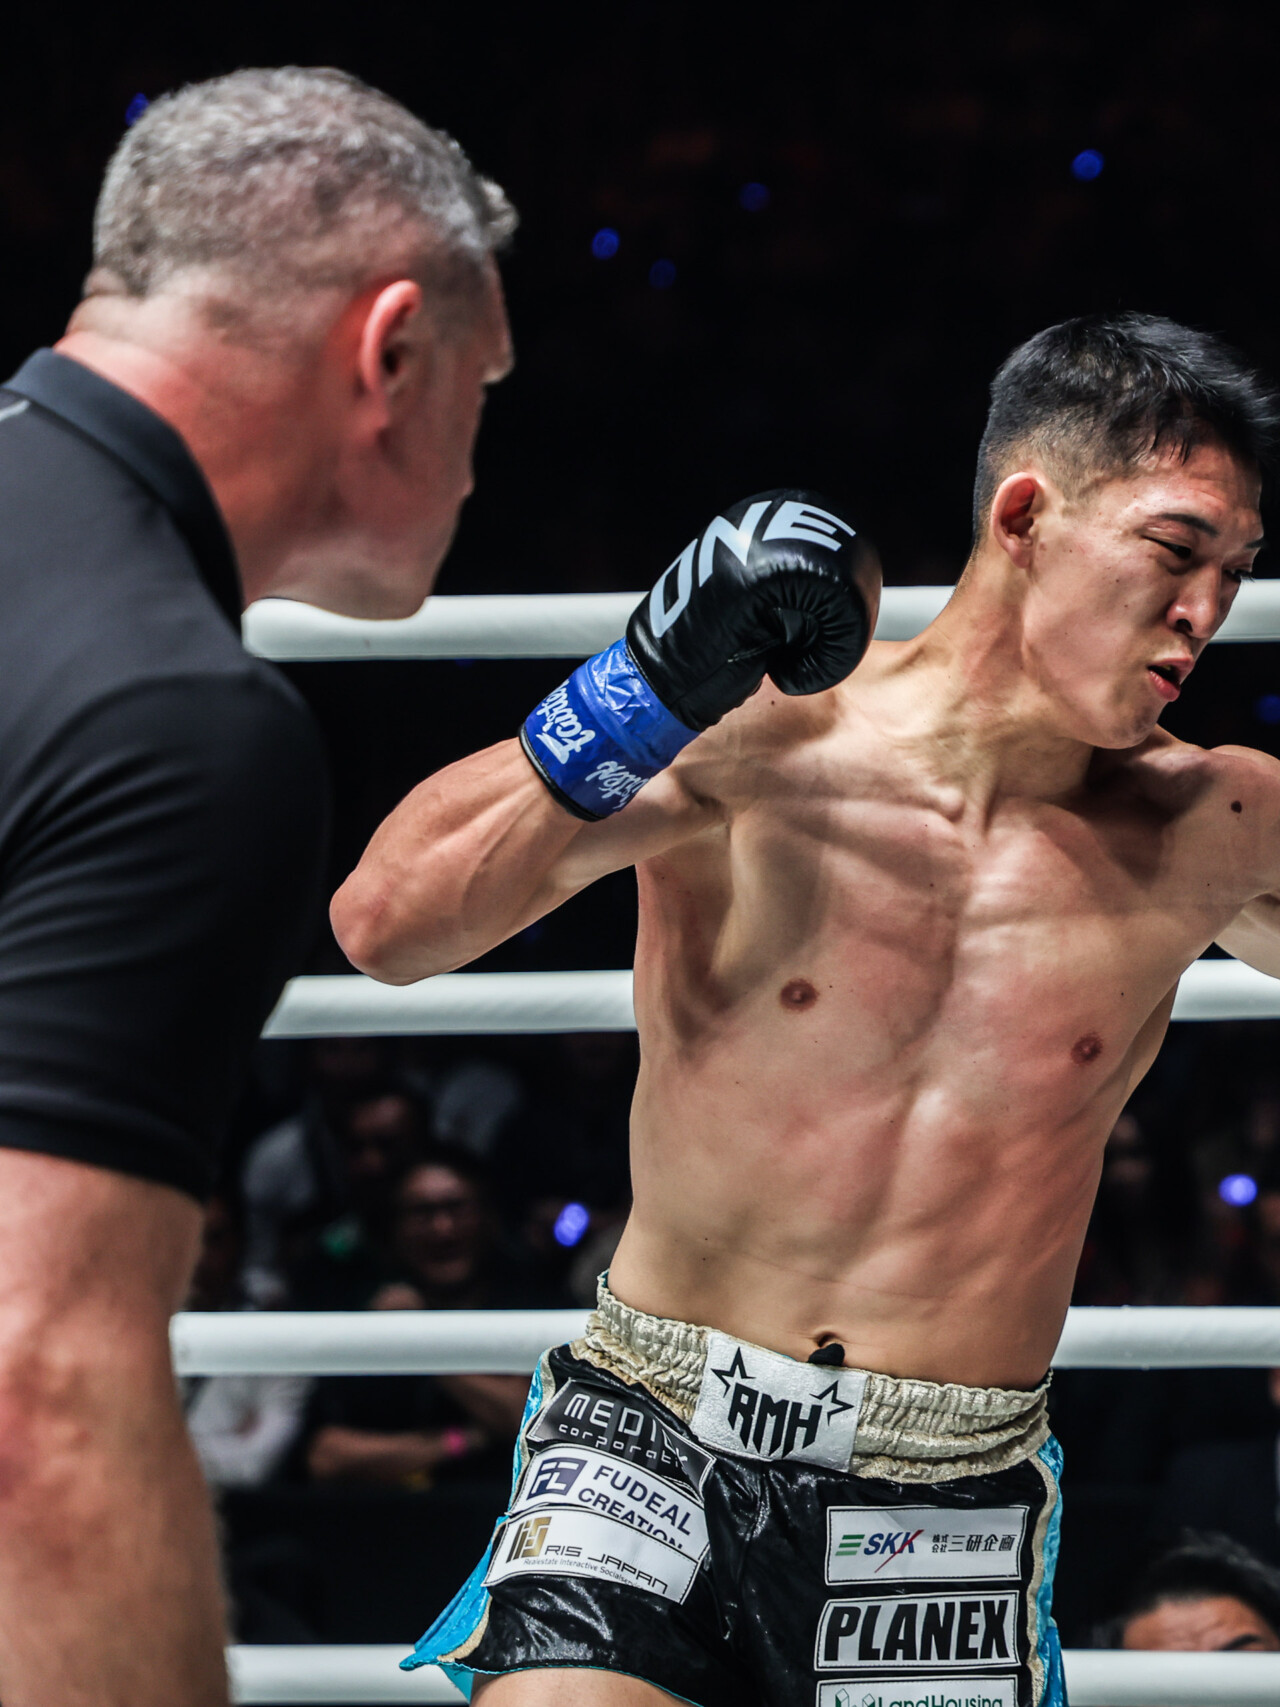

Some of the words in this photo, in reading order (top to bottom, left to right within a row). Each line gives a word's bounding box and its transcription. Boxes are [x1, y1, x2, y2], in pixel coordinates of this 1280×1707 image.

[649, 500, 857, 639] ONE
[578, 1488, 683, 1550] CREATIO
[593, 1465, 692, 1536] FUDEAL
[544, 1545, 583, 1557] RIS
[587, 1553, 668, 1594] JAPAN
[823, 1599, 1010, 1661] PLANEX
